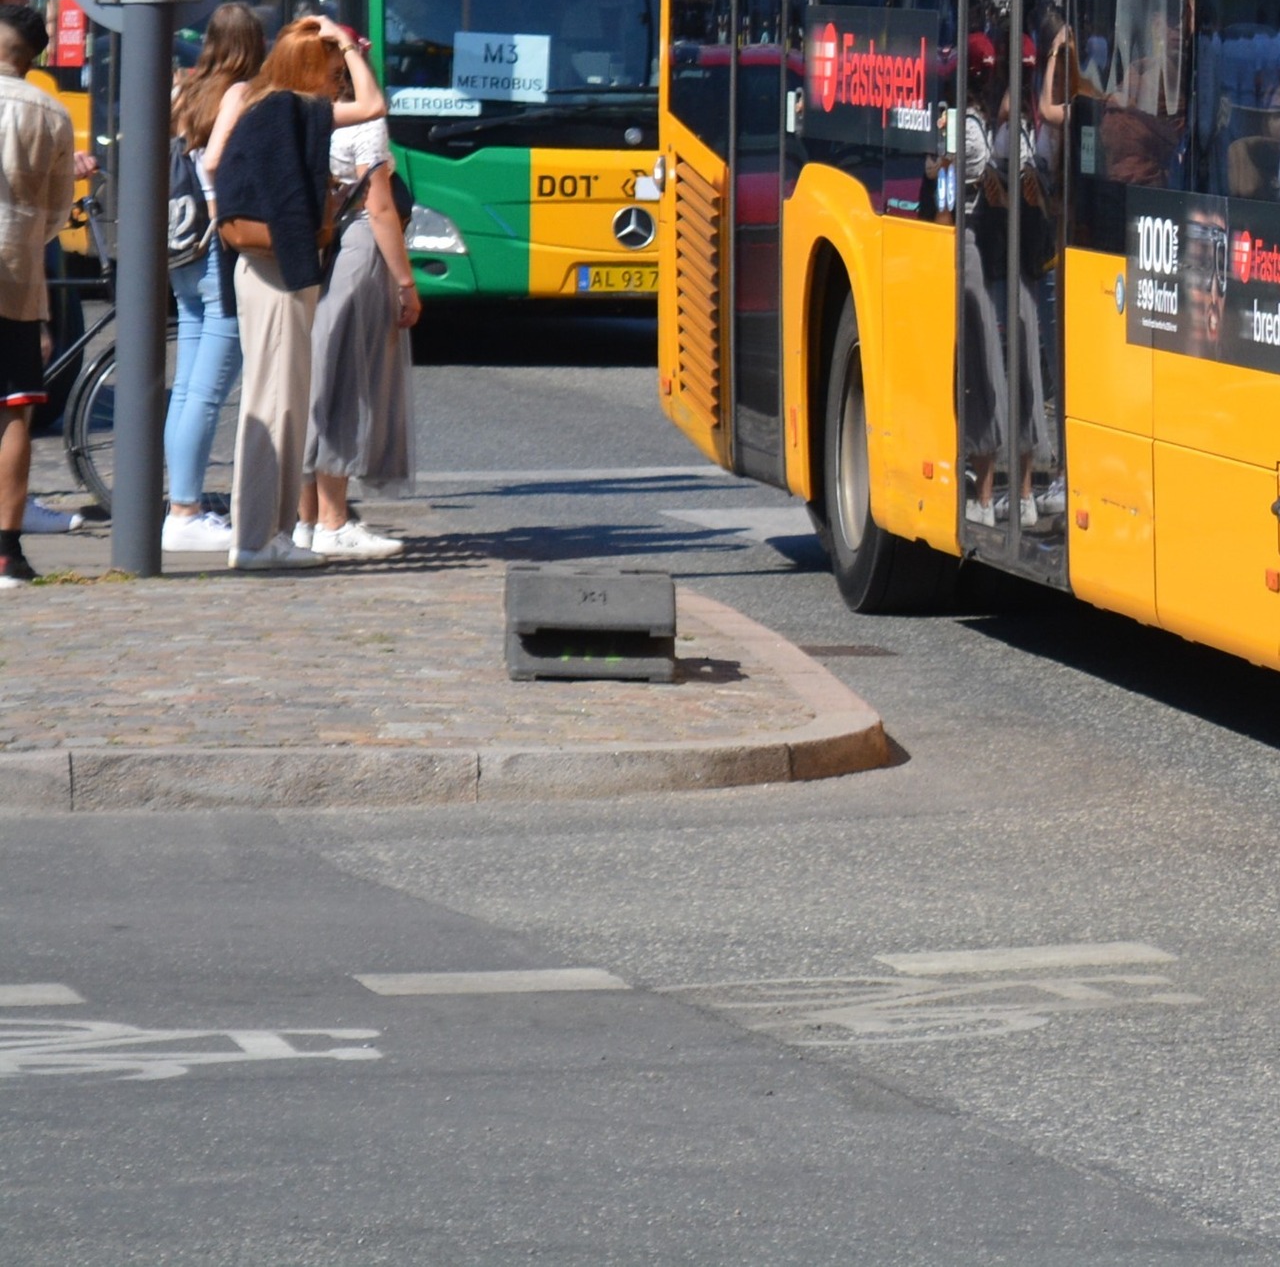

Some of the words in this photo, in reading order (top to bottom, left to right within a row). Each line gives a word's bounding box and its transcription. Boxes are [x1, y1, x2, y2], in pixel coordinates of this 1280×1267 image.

[483, 43, 518, 64] M3
[457, 75, 543, 91] METROBUS
[842, 33, 926, 129] Fastspeed
[537, 175, 599, 198] DOT
[1138, 216, 1173, 275] 1000
[591, 271, 615, 289] AL
[621, 270, 644, 288] 93
